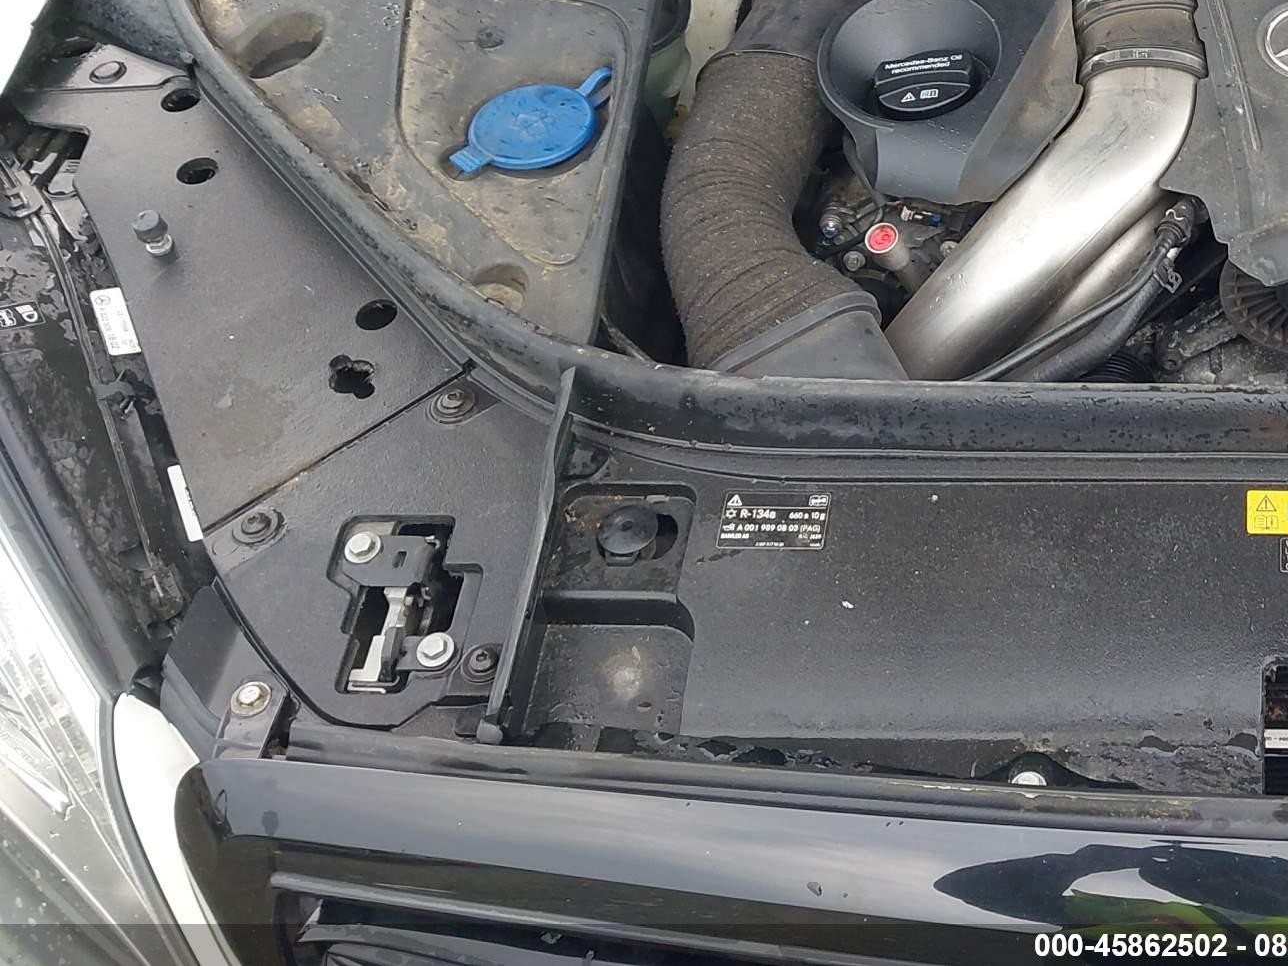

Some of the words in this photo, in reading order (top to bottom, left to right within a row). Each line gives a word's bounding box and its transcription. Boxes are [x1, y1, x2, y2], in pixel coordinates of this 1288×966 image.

[885, 57, 949, 69] Mercedes-Benz
[891, 61, 950, 74] recommended
[737, 523, 744, 532] A
[744, 523, 759, 532] 001
[761, 523, 776, 532] 989
[788, 523, 799, 532] 03
[800, 523, 821, 533] (PAG)
